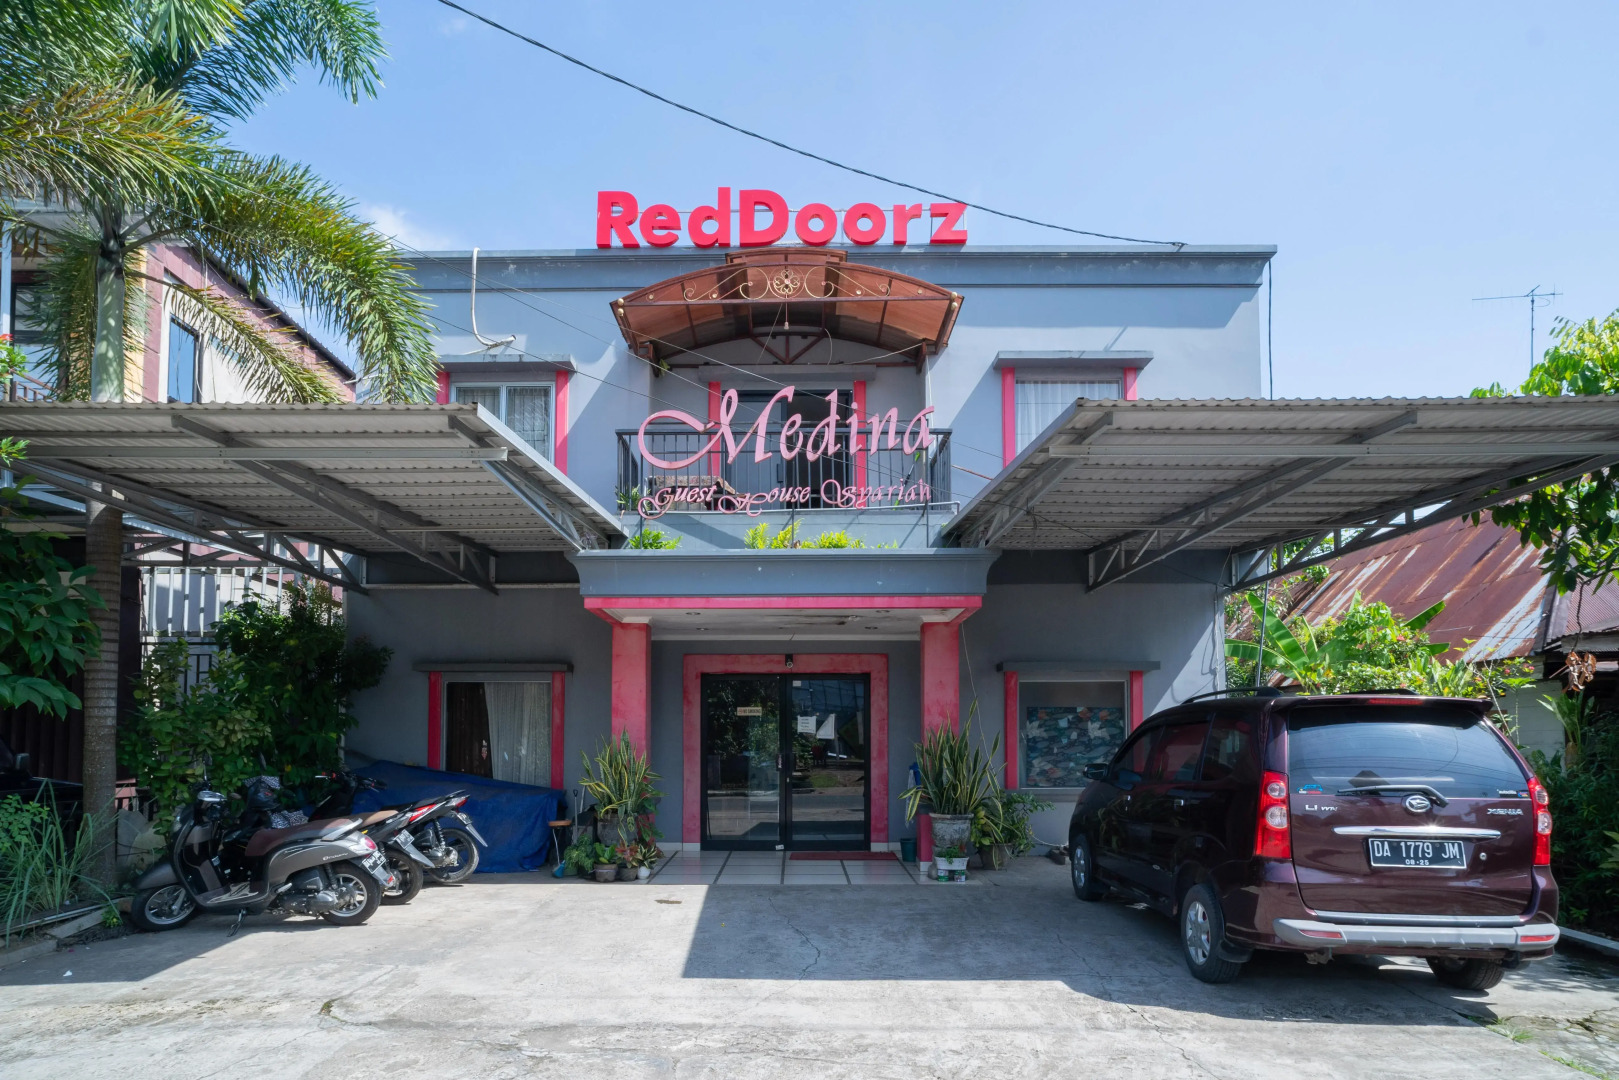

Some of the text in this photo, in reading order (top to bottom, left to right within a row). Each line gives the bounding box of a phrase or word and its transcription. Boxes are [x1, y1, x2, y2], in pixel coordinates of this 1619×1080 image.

[596, 187, 968, 249] RedDoorz
[637, 385, 936, 470] Medina
[637, 478, 932, 520] Guest House Syariah
[1373, 841, 1460, 859] DA 1779 JM
